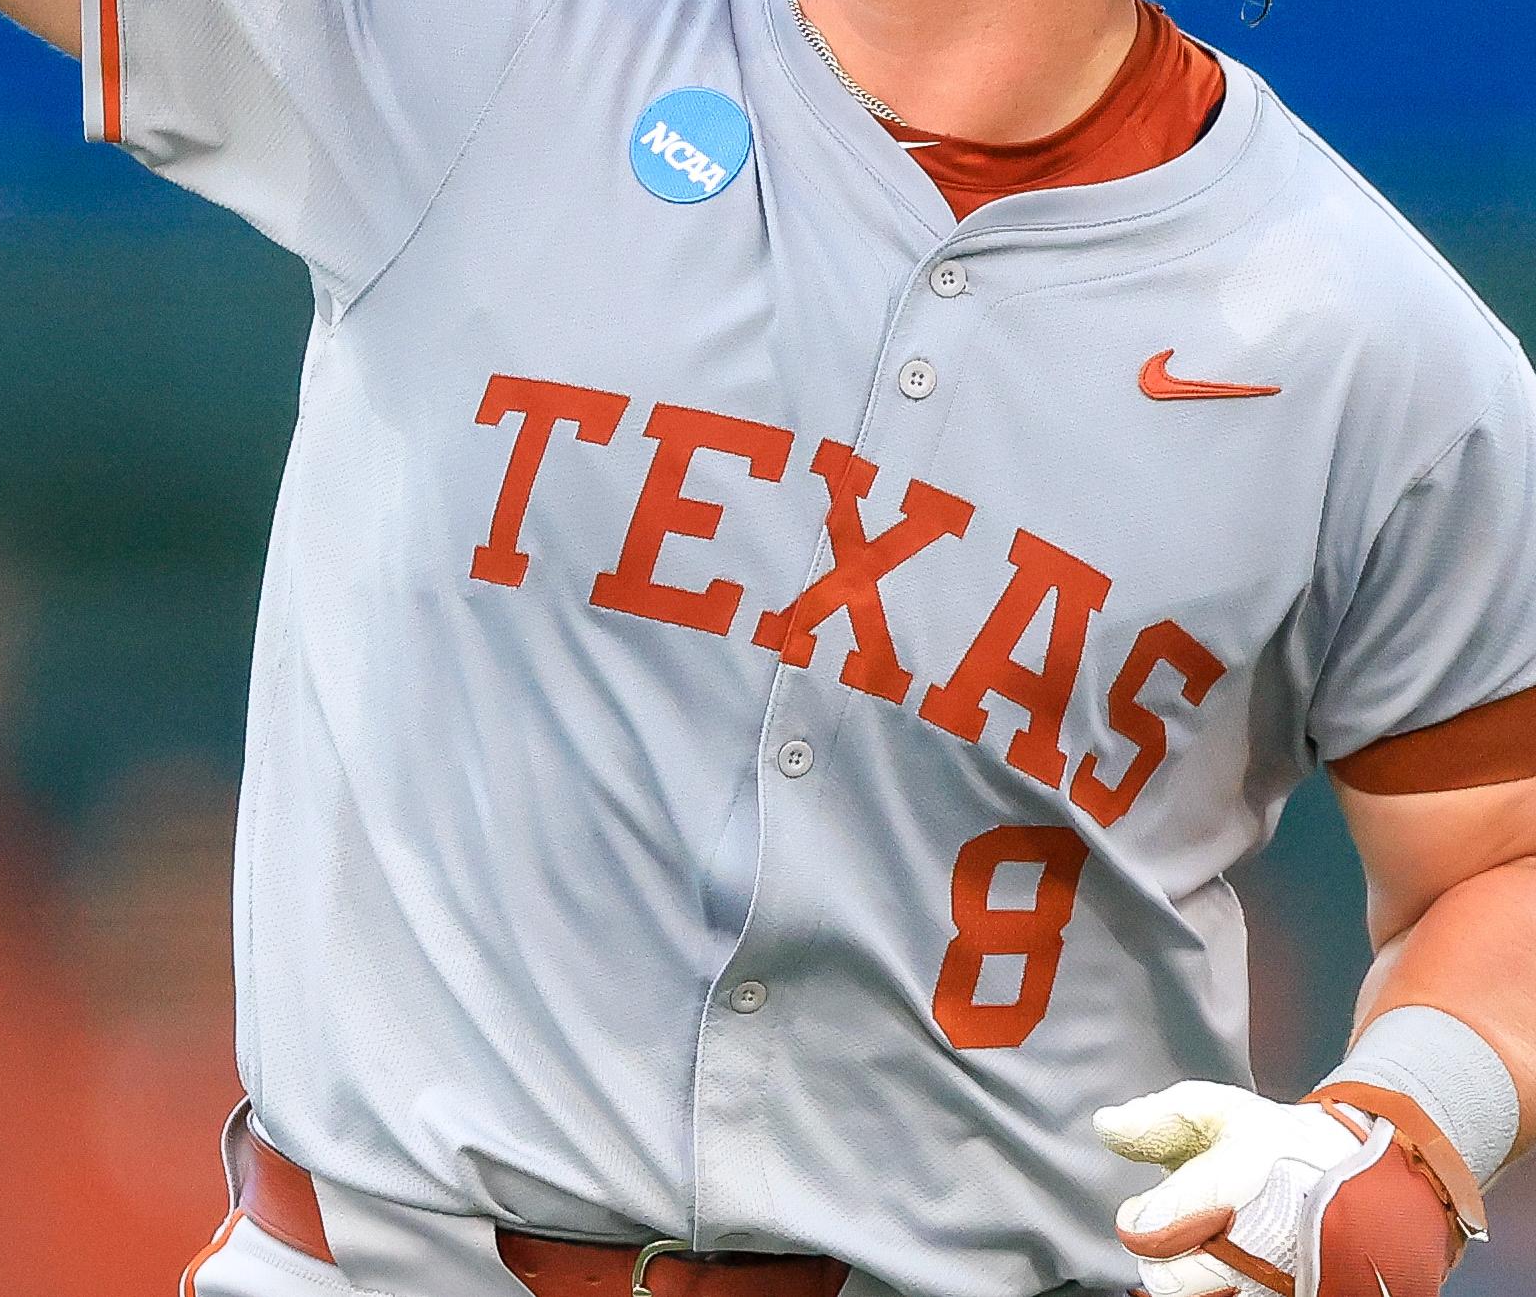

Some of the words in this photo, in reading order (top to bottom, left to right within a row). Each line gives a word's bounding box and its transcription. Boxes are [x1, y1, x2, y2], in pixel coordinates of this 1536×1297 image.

[639, 121, 727, 192] NCAA
[470, 374, 1227, 828] TEXAS
[932, 825, 1089, 1050] 8
